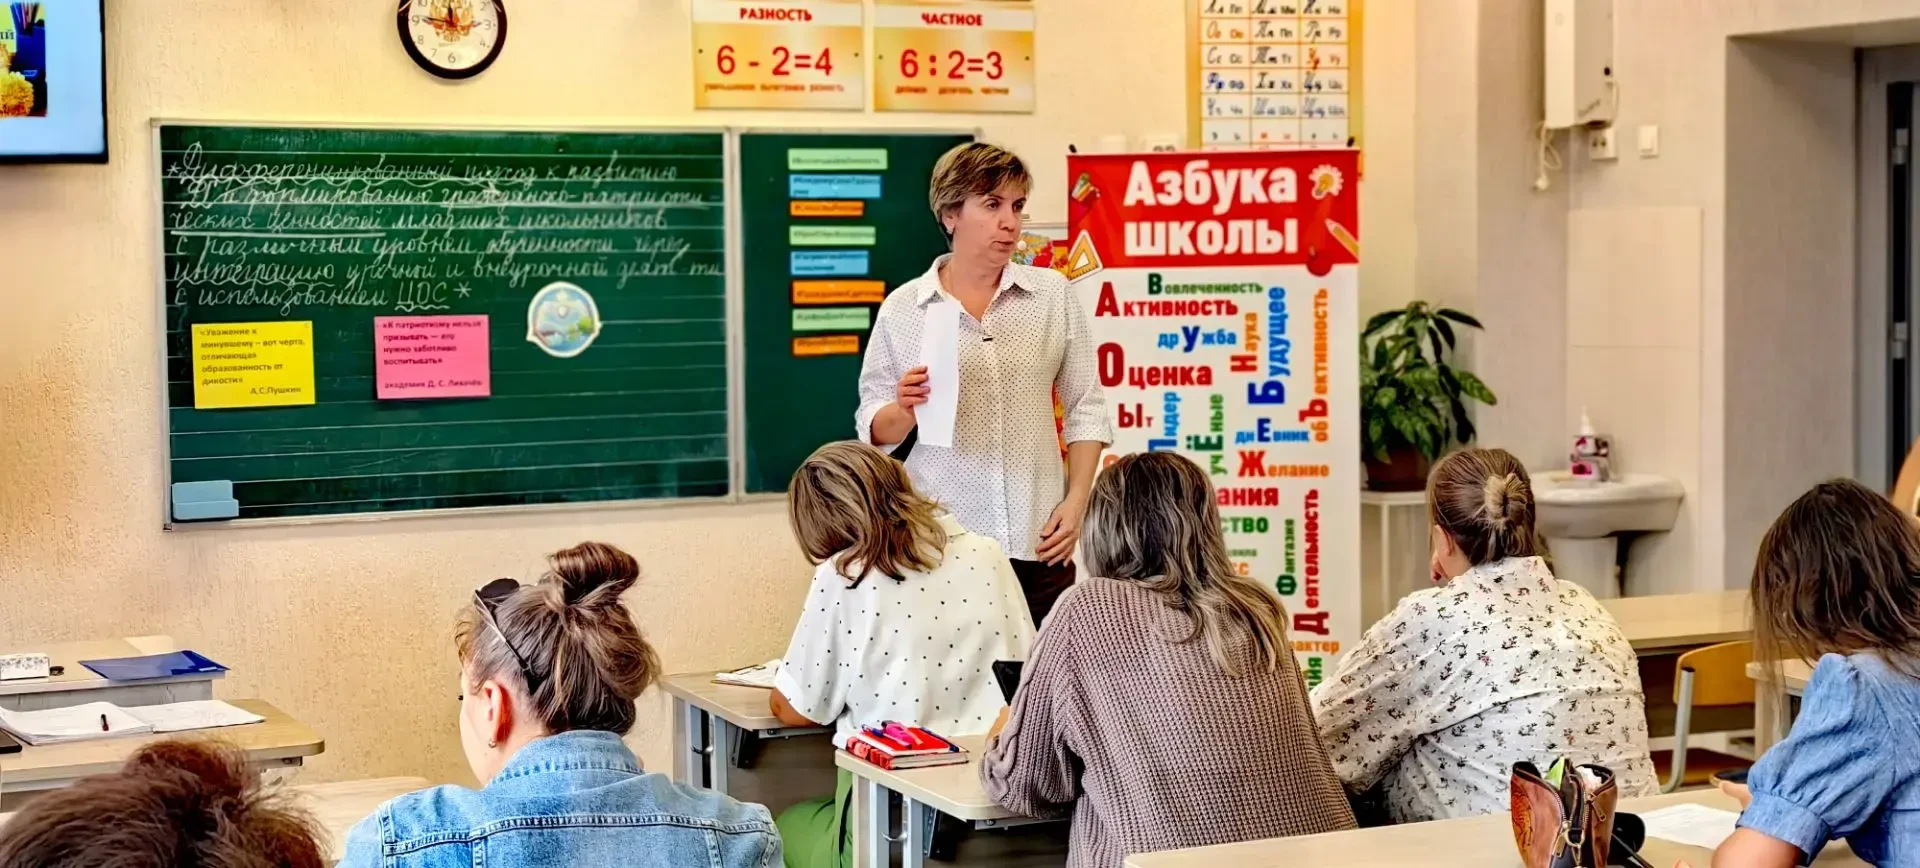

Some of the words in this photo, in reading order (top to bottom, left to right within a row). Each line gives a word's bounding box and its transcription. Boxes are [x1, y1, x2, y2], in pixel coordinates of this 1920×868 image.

[739, 7, 813, 22] РАЗНОСТЬ
[921, 12, 984, 27] ЧАСТНОЕ
[716, 44, 735, 75] 6
[771, 46, 833, 77] 2=4
[900, 49, 919, 79] 6
[947, 50, 1004, 80] 2=3
[547, 163, 562, 180] к
[567, 150, 678, 190] развитию
[1123, 159, 1298, 216] Азбука
[247, 182, 434, 217] формированию
[170, 212, 257, 230] ческих
[267, 210, 384, 233] ценностей
[391, 213, 510, 242] младших
[518, 210, 668, 230] школьников
[1124, 218, 1299, 258] школы
[197, 236, 364, 277] различным
[372, 228, 477, 268] уровнем
[174, 260, 336, 292] интеграцию
[346, 255, 434, 293] урочной
[445, 261, 464, 277] и
[473, 252, 608, 288] внеурочной
[1147, 272, 1264, 296] Вовлеченность
[198, 284, 389, 317] использованием
[397, 281, 447, 309] ЦОС
[1095, 281, 1239, 320] Активность
[1230, 311, 1261, 374] Наука
[1247, 285, 1291, 405] Будущее
[1097, 341, 1213, 391] Оценка
[1118, 402, 1154, 429] Ыт
[1238, 450, 1329, 478] Желание
[1217, 487, 1279, 507] ания
[1276, 518, 1297, 596] Фантазия
[1293, 488, 1330, 636] Деятельность
